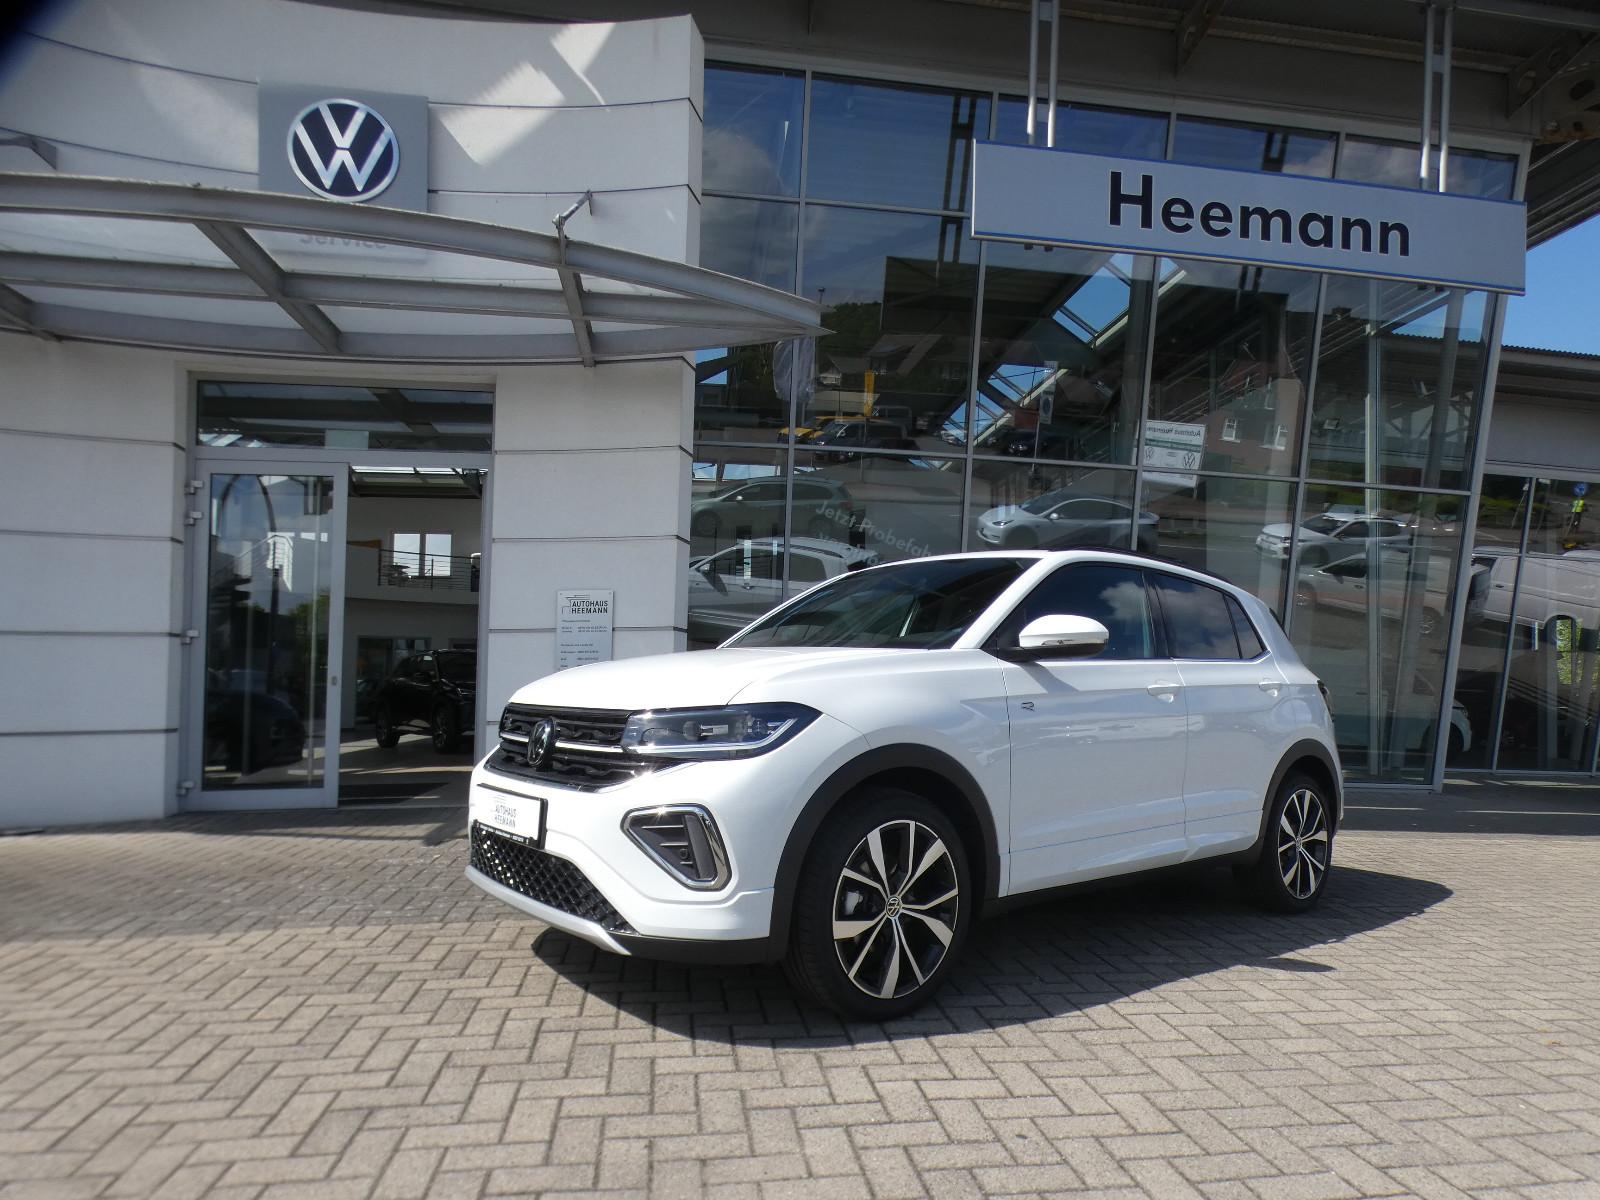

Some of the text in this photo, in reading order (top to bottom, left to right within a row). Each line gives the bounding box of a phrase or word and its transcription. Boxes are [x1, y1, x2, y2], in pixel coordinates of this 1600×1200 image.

[287, 99, 399, 202] VW
[1109, 170, 1410, 257] Heemann
[815, 500, 857, 528] Jetzt
[571, 600, 608, 608] AUTOHAUS
[495, 804, 517, 819] AUTOHAUS
